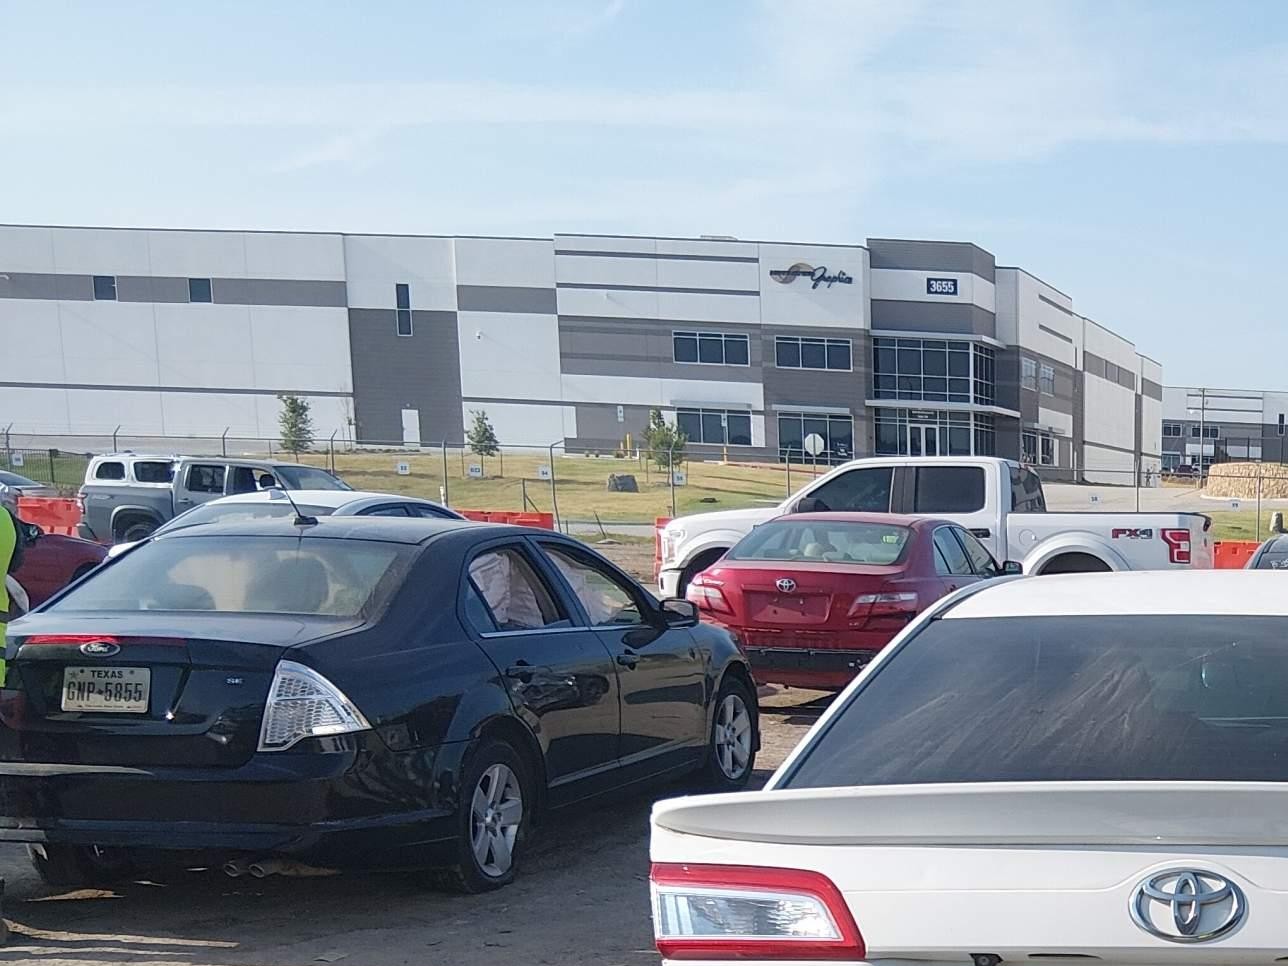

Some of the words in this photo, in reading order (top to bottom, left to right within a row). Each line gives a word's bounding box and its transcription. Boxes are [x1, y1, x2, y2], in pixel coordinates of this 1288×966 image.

[930, 280, 955, 293] 3655
[1111, 528, 1153, 539] FX4
[90, 669, 124, 679] TEXAS
